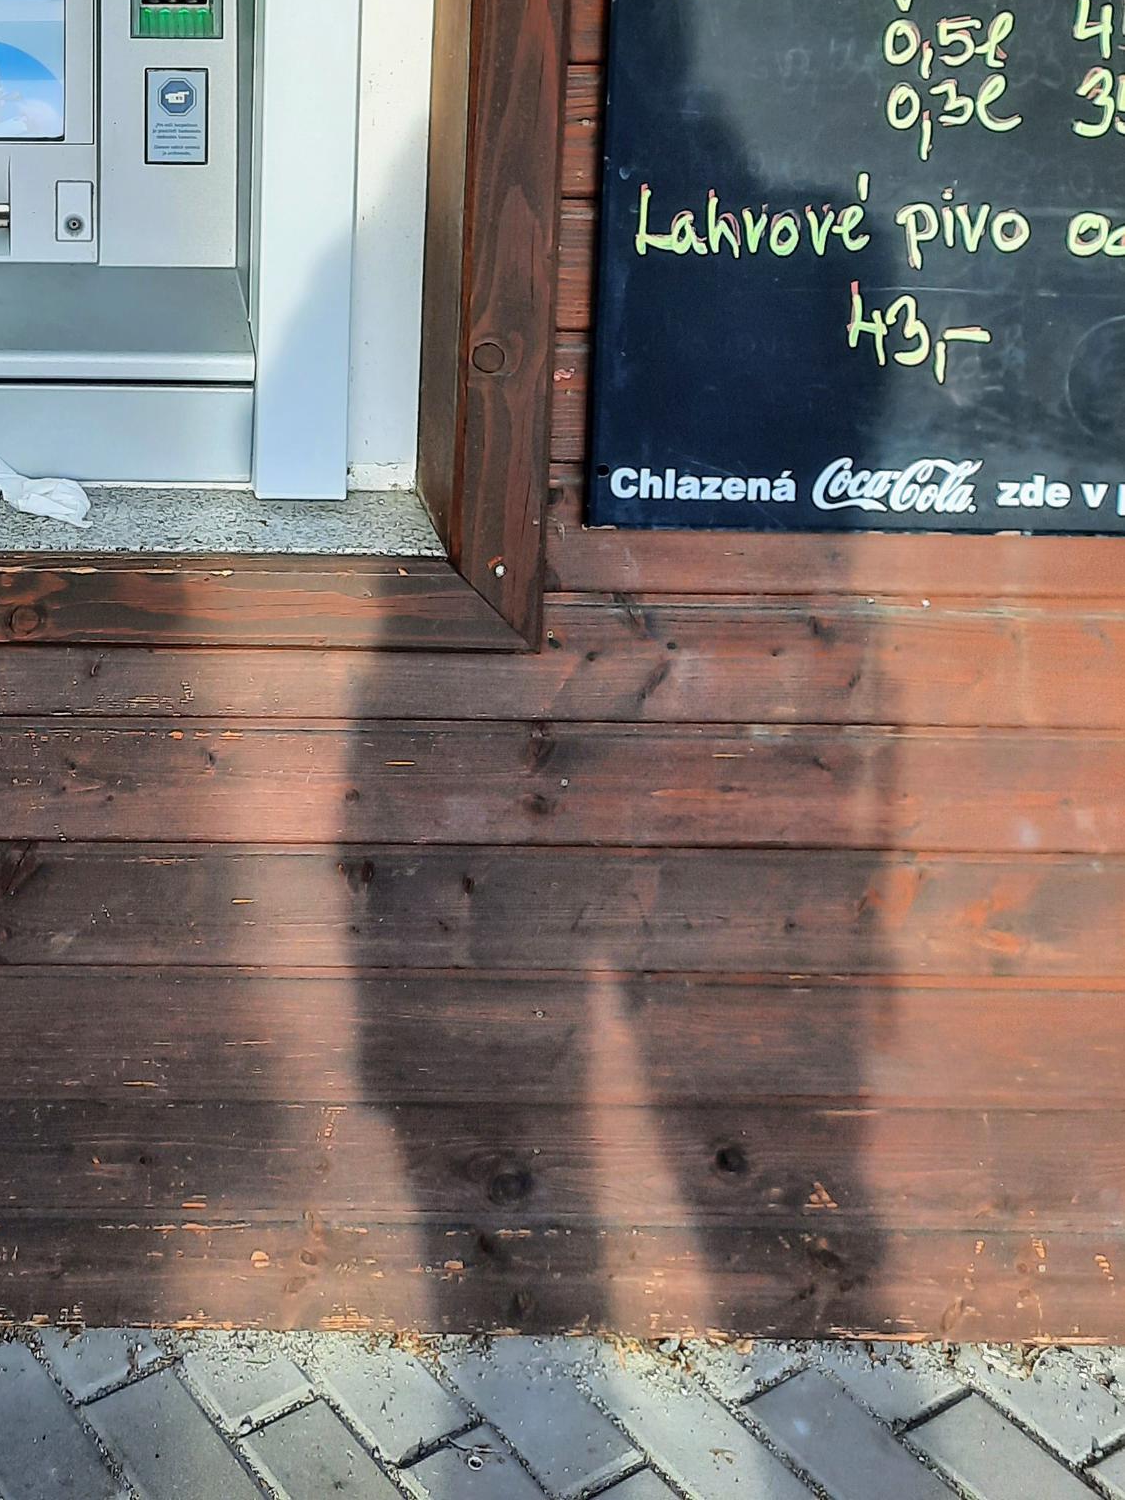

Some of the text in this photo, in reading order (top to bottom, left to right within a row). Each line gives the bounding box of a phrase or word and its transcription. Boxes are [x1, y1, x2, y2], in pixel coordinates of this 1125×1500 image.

[634, 170, 872, 259] Lahvové
[895, 186, 1031, 271] pivo
[610, 466, 797, 503] Chlazená
[811, 456, 984, 514] Coca-Cola
[996, 473, 1072, 509] zde
[1080, 482, 1110, 509] v
